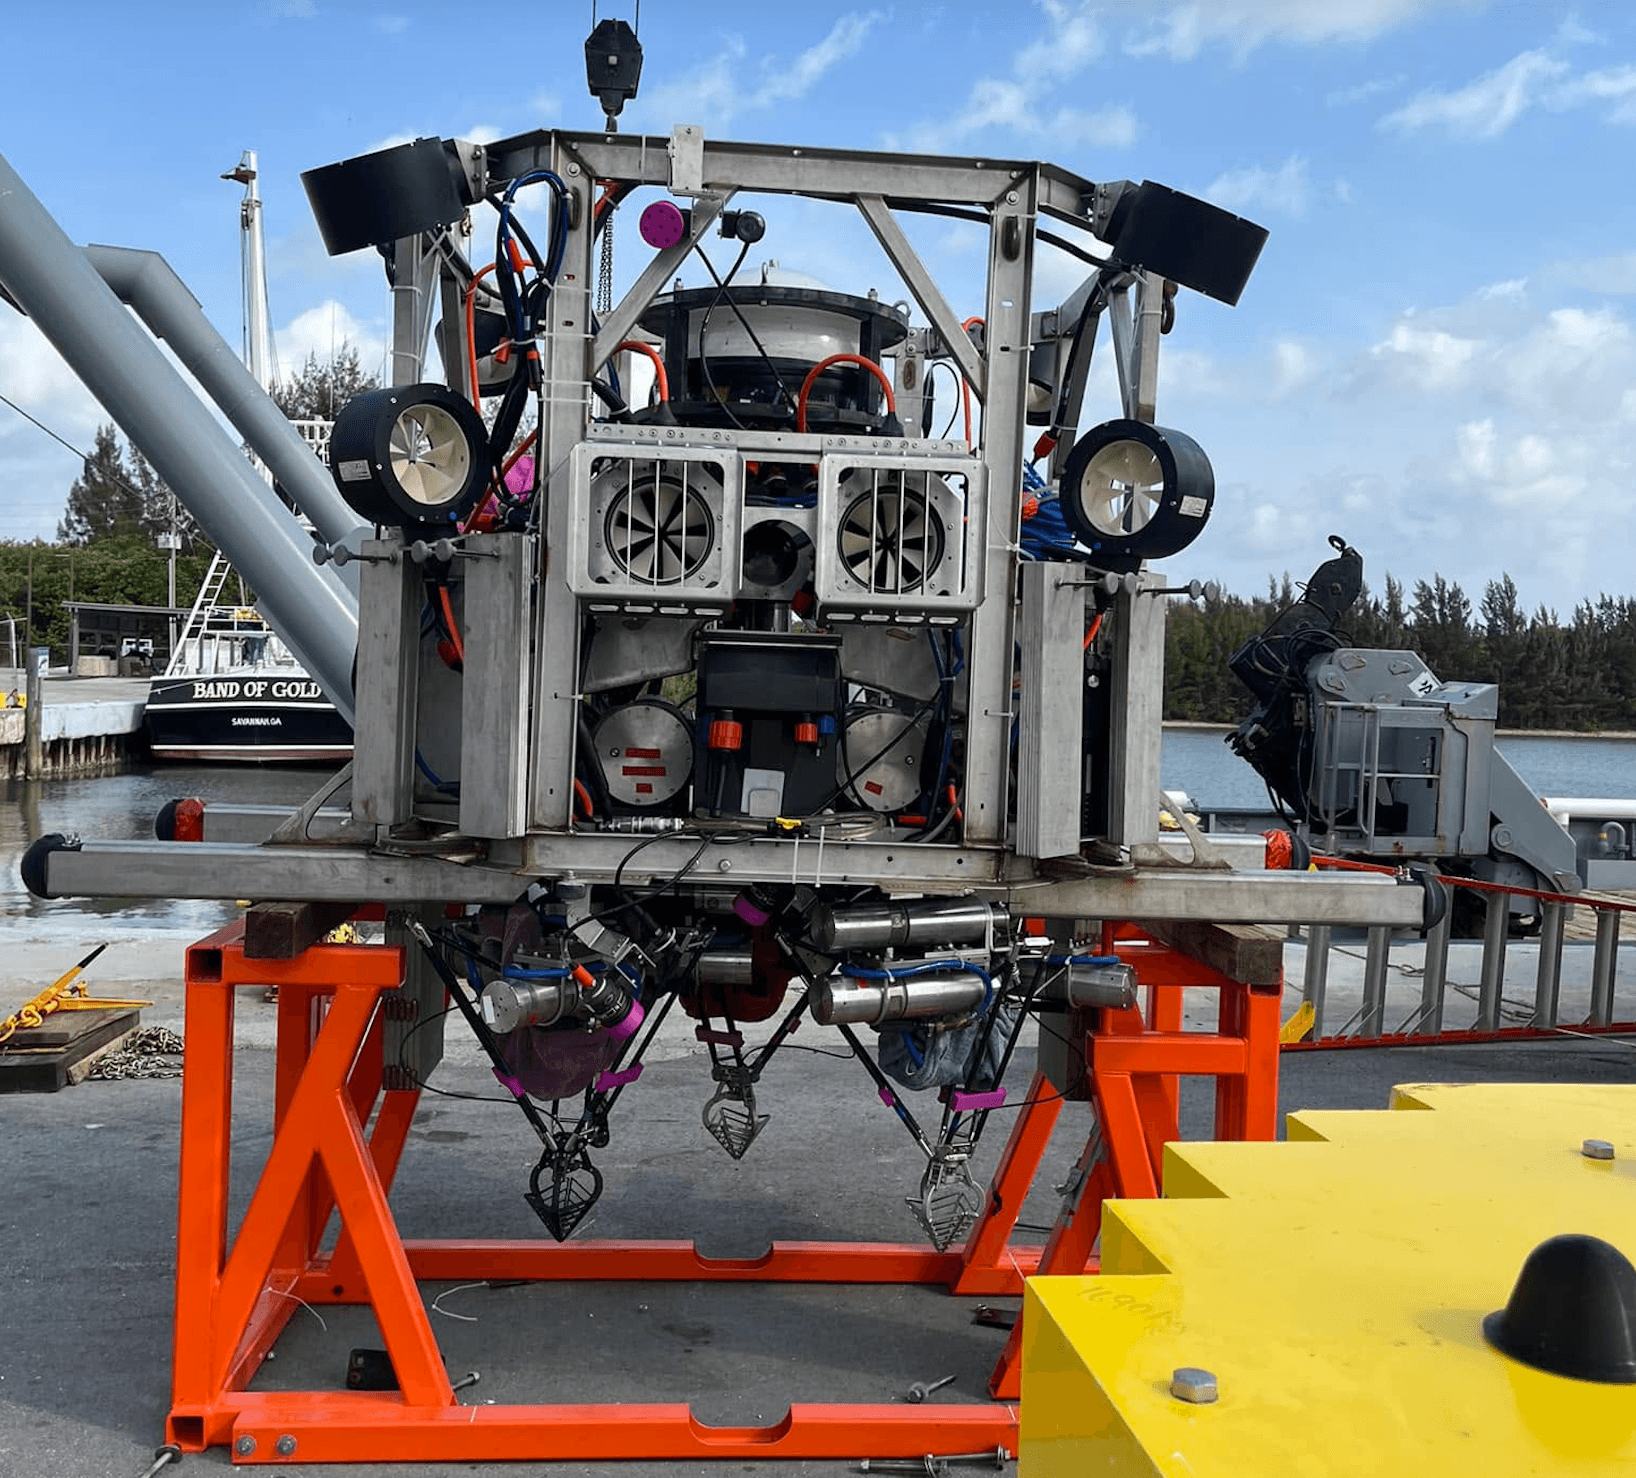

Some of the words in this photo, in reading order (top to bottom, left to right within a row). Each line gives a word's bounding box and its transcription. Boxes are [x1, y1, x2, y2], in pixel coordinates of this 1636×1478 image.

[192, 681, 240, 699] BAND
[243, 681, 268, 698] OF
[271, 681, 322, 698] GOLD
